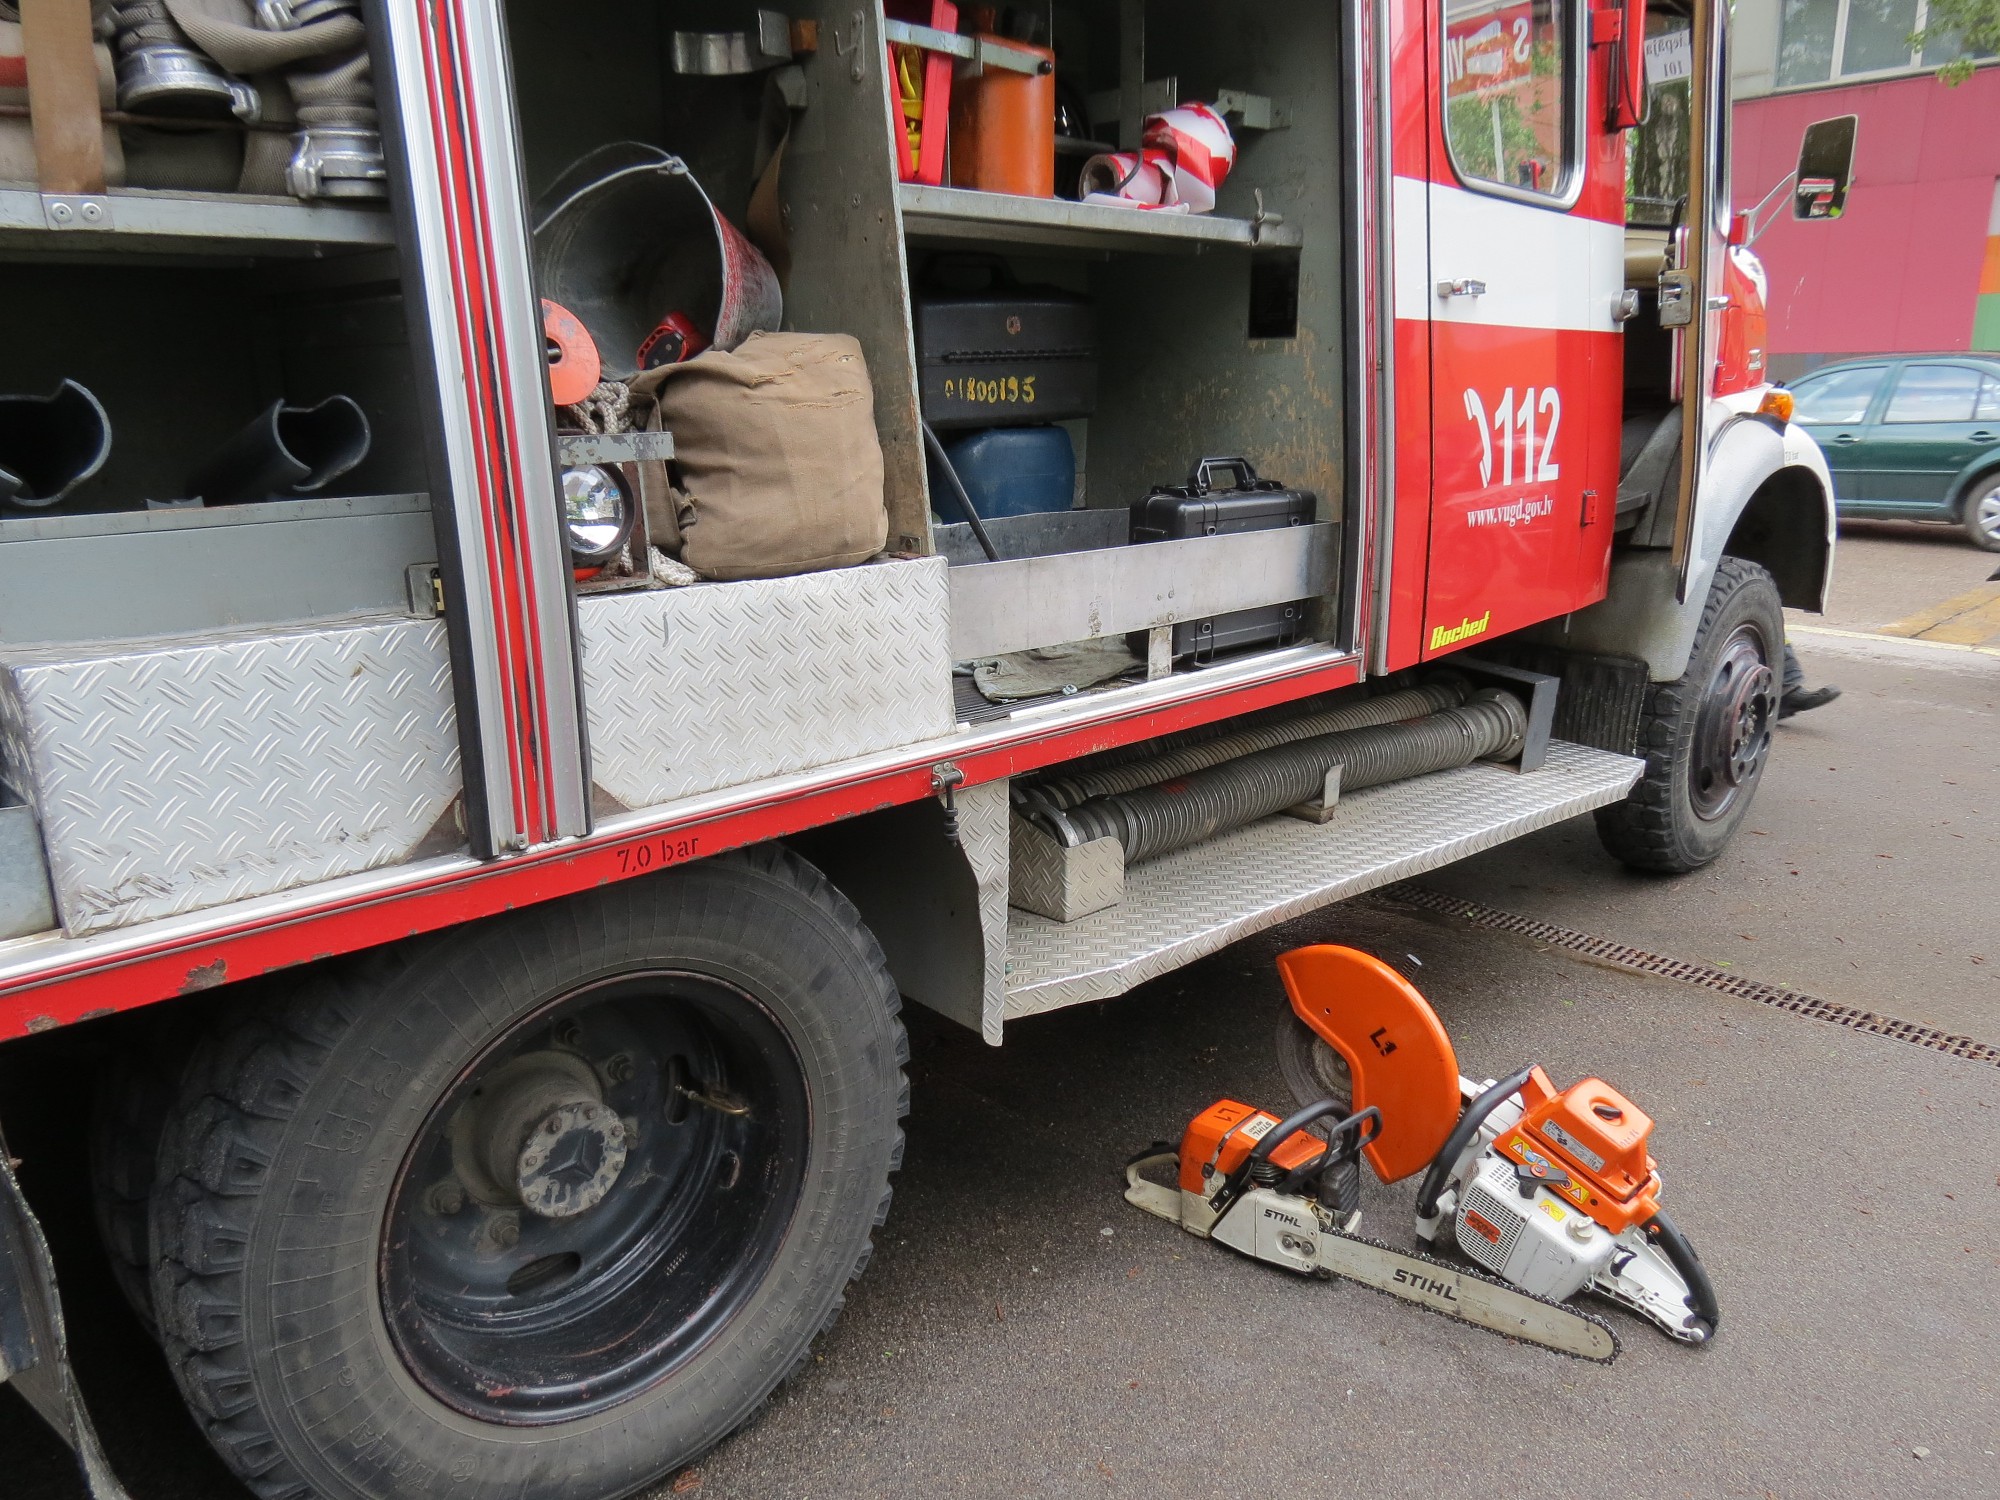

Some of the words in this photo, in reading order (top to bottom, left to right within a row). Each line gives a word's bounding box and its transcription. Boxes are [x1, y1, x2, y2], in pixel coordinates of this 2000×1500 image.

[1494, 387, 1561, 486] 112
[1467, 495, 1554, 528] www.vugd.gov.lv
[661, 838, 698, 862] bar
[1252, 1121, 1272, 1138] STIHL
[1263, 1208, 1301, 1228] STIHL
[1393, 1268, 1458, 1302] STIHL
